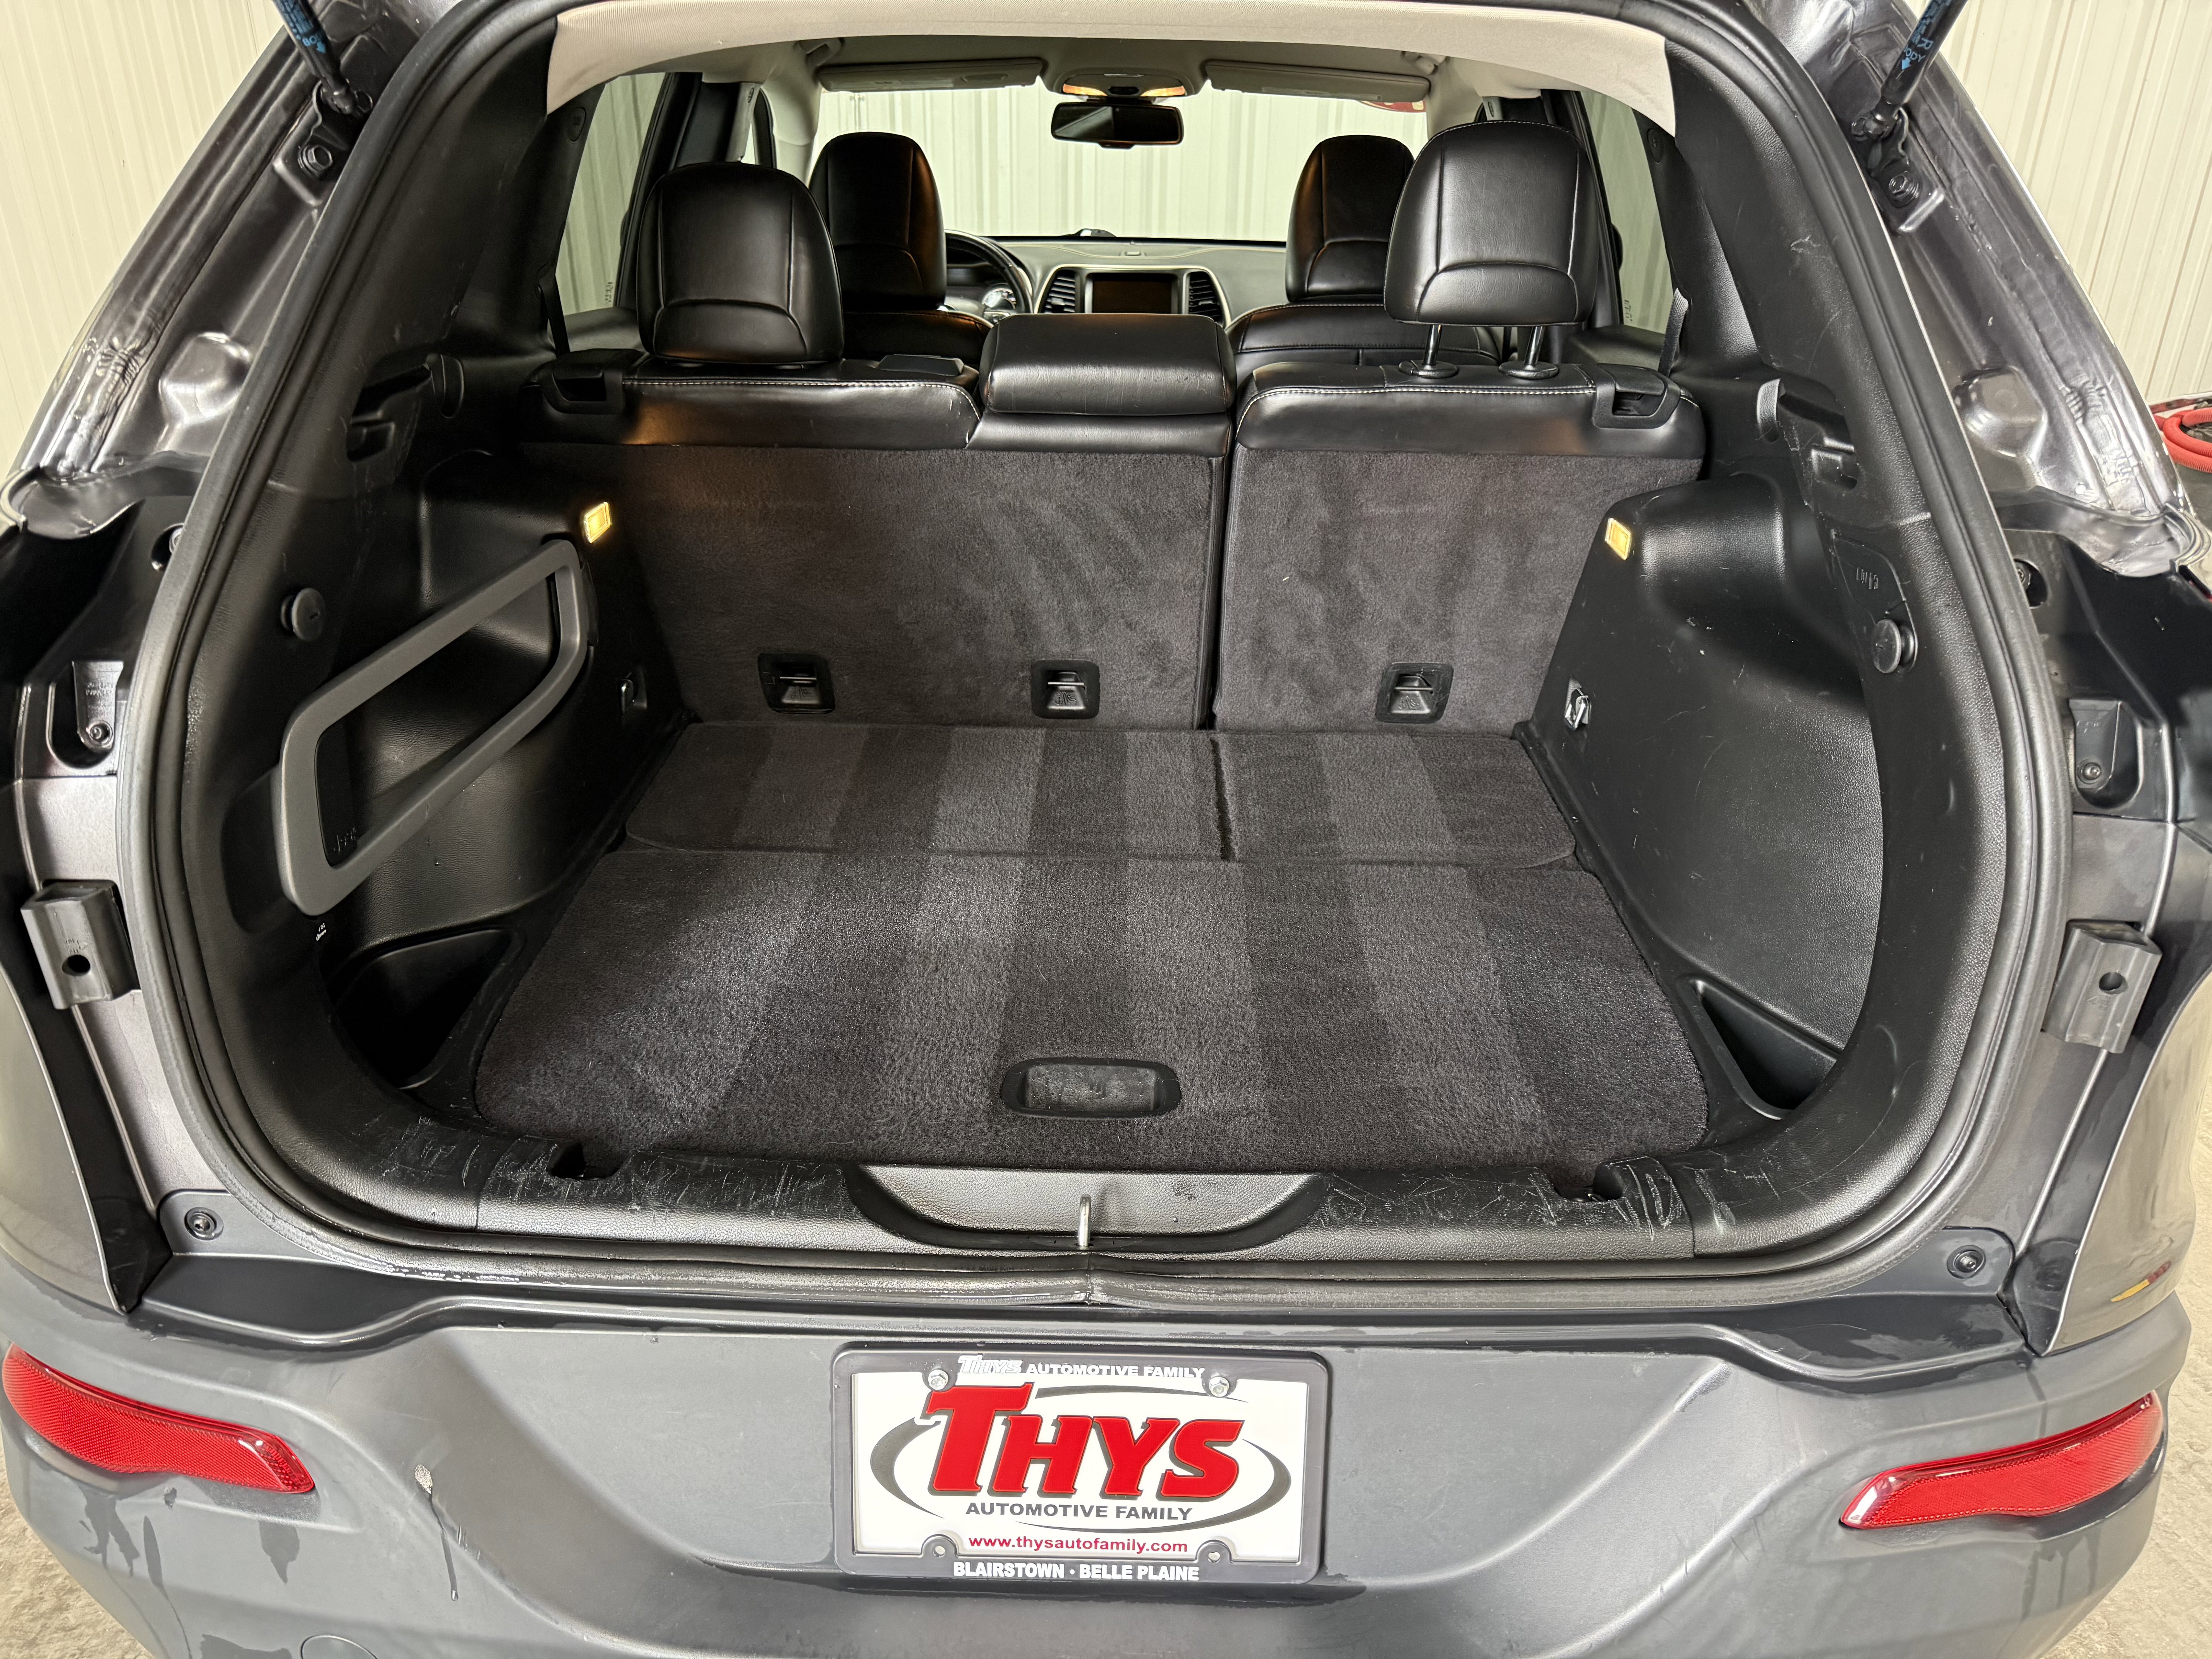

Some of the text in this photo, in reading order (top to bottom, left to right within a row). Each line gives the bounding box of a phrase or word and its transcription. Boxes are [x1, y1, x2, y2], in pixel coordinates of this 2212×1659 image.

[958, 1355, 1205, 1377] THYS AUTOMOTIVE FAMILY
[925, 1381, 1245, 1499] THYS
[966, 1503, 1192, 1520] AUTOMOTIVE FAMILY
[969, 1536, 1187, 1554] www.thysautofamily.com
[953, 1561, 1199, 1581] BLAIRSTOWN BELLE PLAINE
